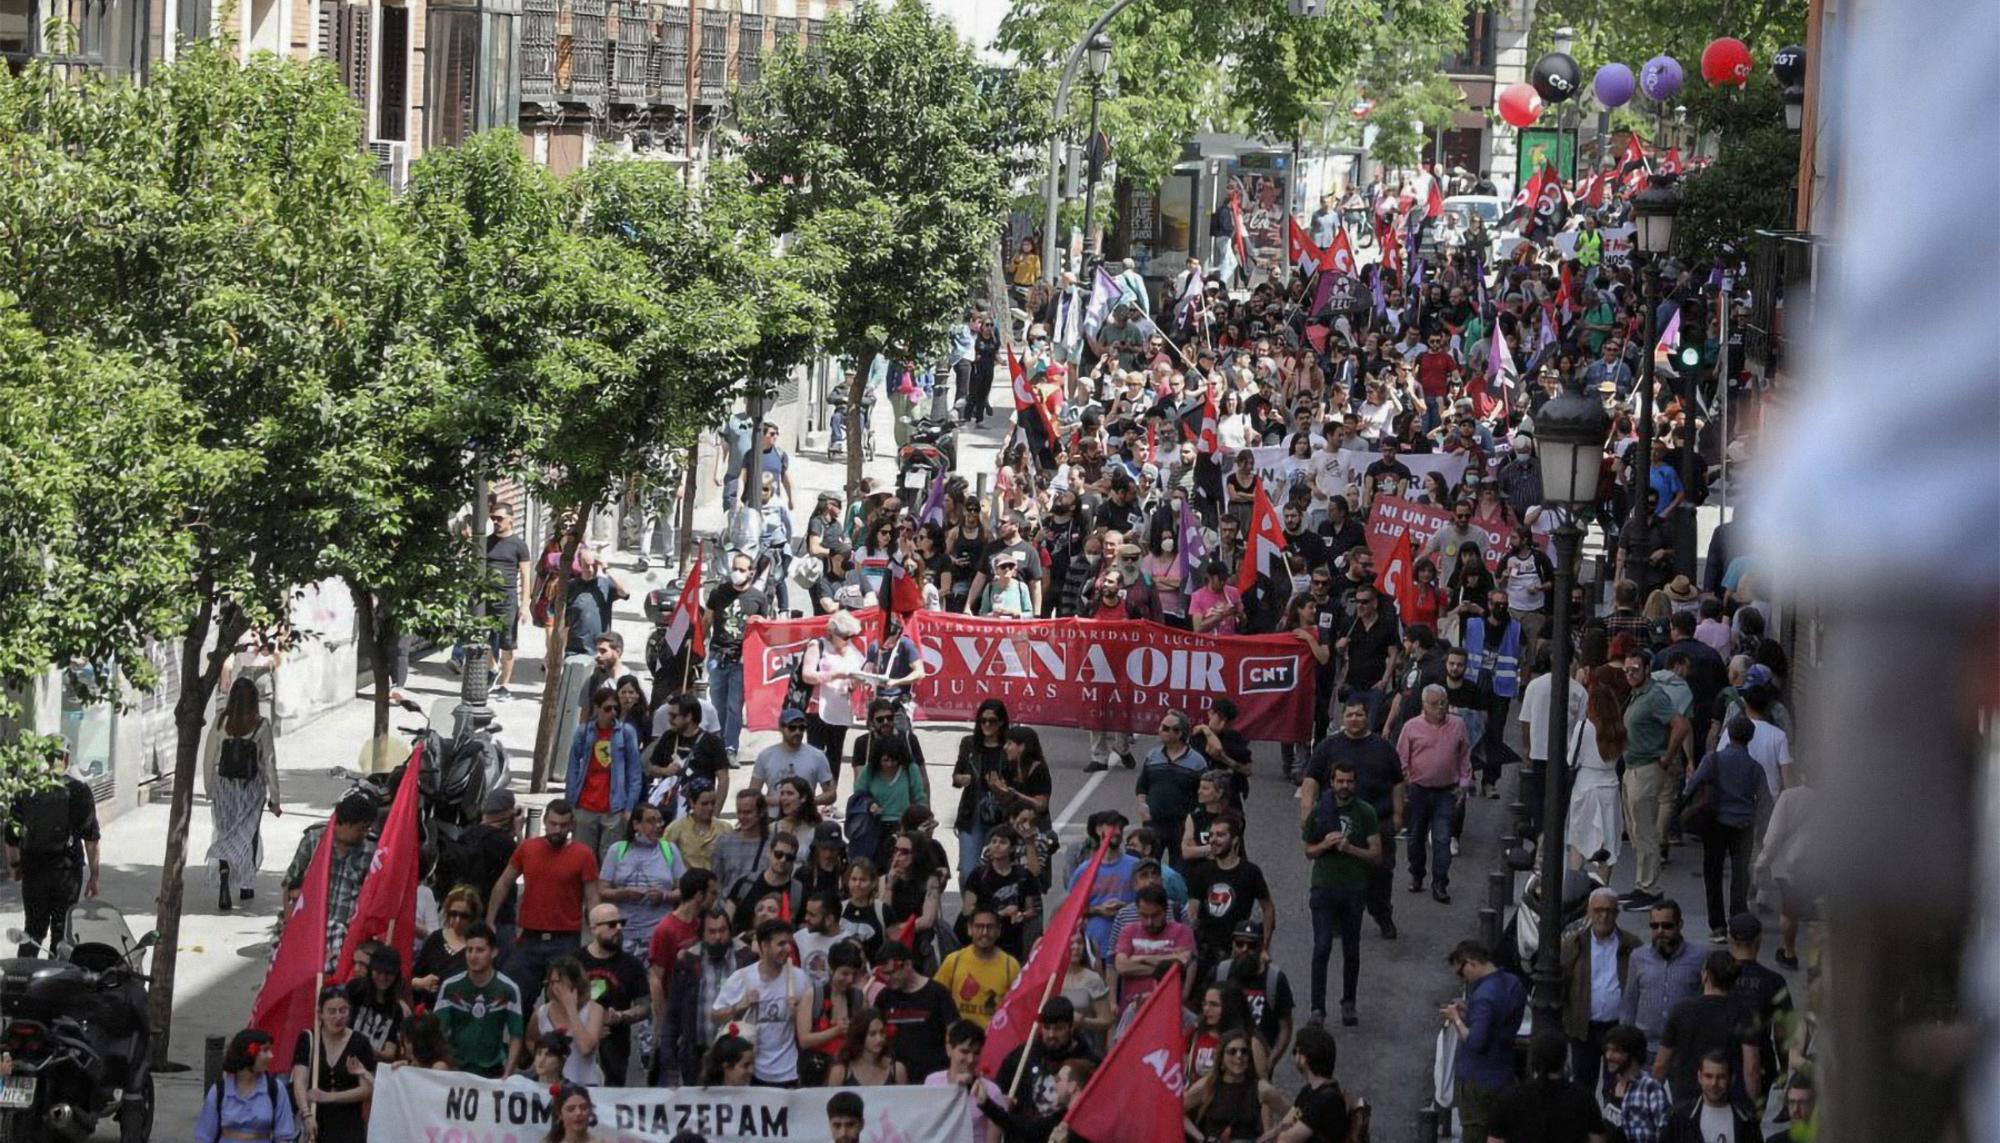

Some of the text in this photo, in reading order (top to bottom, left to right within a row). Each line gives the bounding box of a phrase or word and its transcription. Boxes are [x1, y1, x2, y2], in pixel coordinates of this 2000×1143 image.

[1548, 73, 1573, 93] CGT
[1379, 503, 1397, 519] NI
[1402, 510, 1426, 526] UN
[1029, 626, 1141, 642] SOLIDARIDAD
[1149, 632, 1157, 644] Y
[1163, 633, 1216, 648] LUCHA
[952, 635, 1067, 681] VAN
[1126, 646, 1227, 692] OIR
[1249, 666, 1288, 682] CNT
[934, 679, 1213, 710] JUNTAS MADRID
[446, 1086, 479, 1122] NO
[615, 1103, 789, 1137] DIAZEPAM
